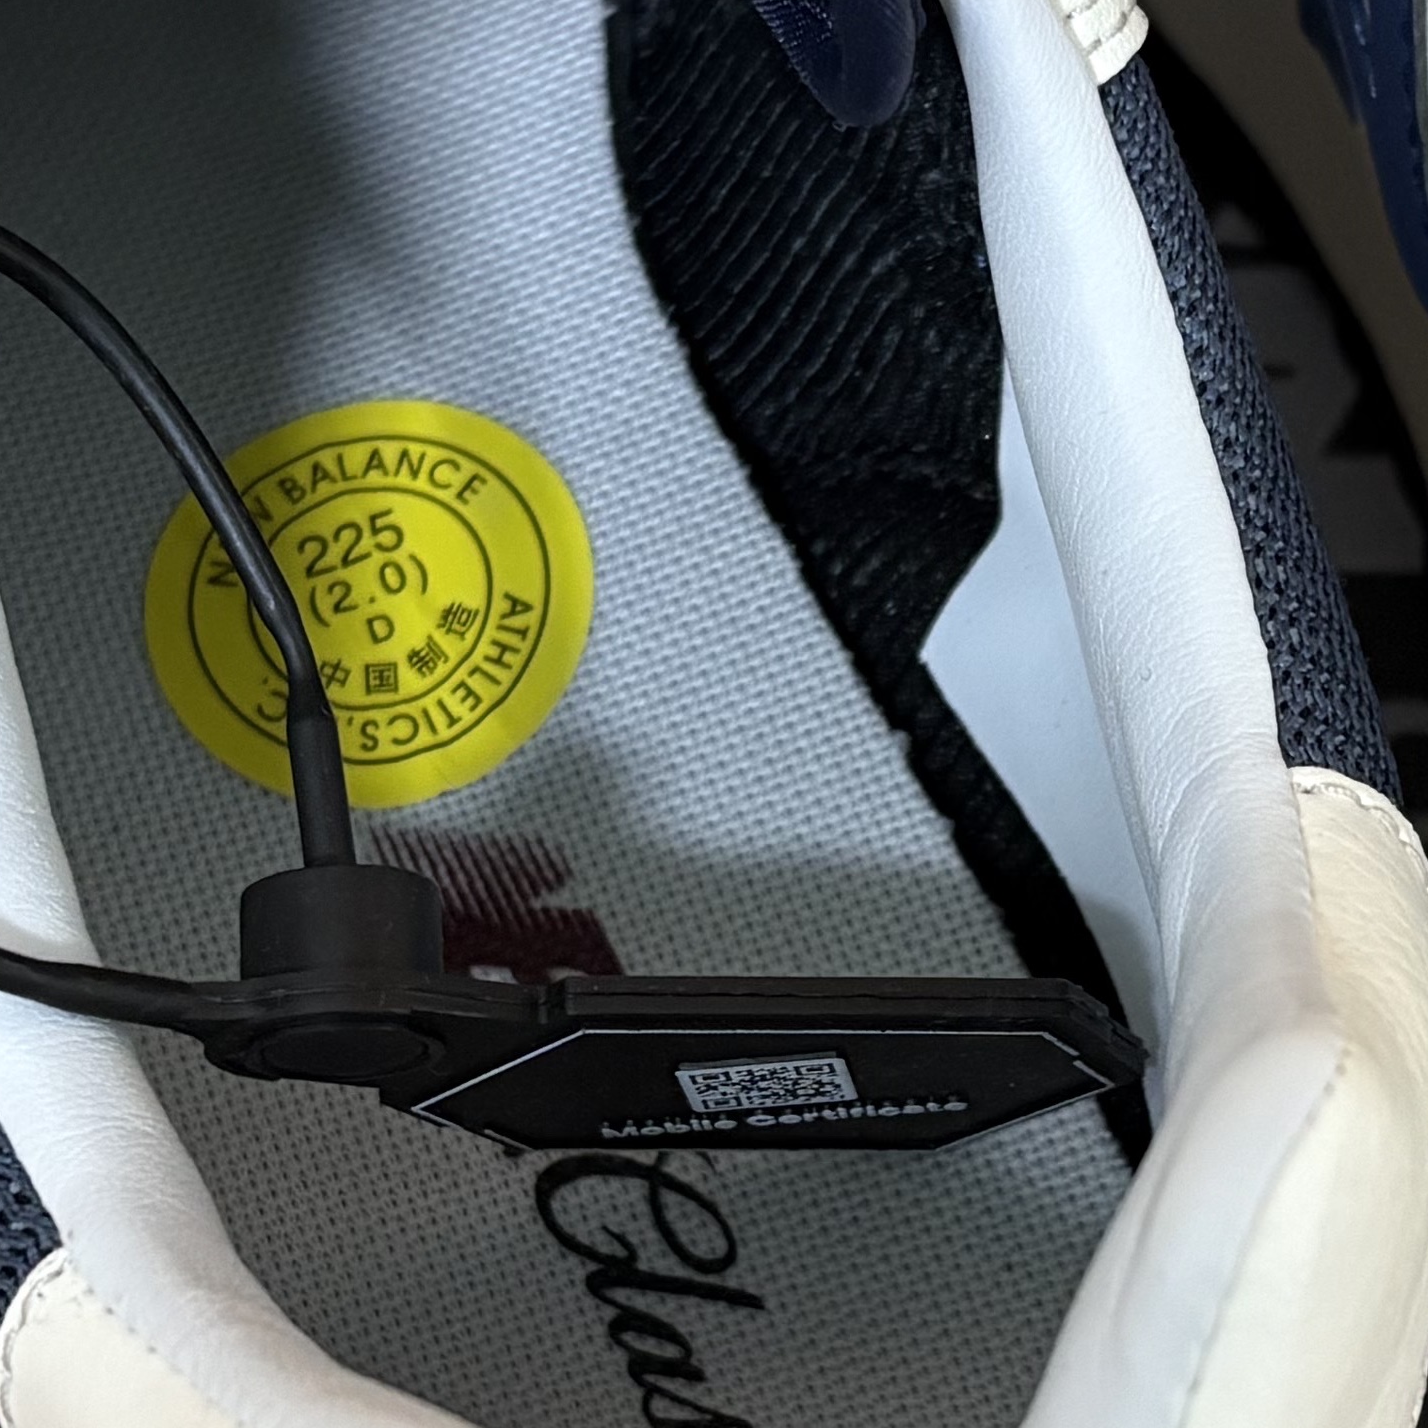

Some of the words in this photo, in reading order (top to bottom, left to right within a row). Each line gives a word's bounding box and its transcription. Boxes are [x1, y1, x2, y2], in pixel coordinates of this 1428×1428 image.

[278, 446, 488, 507] BALANCE
[296, 507, 406, 579] 225
[309, 554, 429, 627] (2.0)
[368, 614, 396, 645] D
